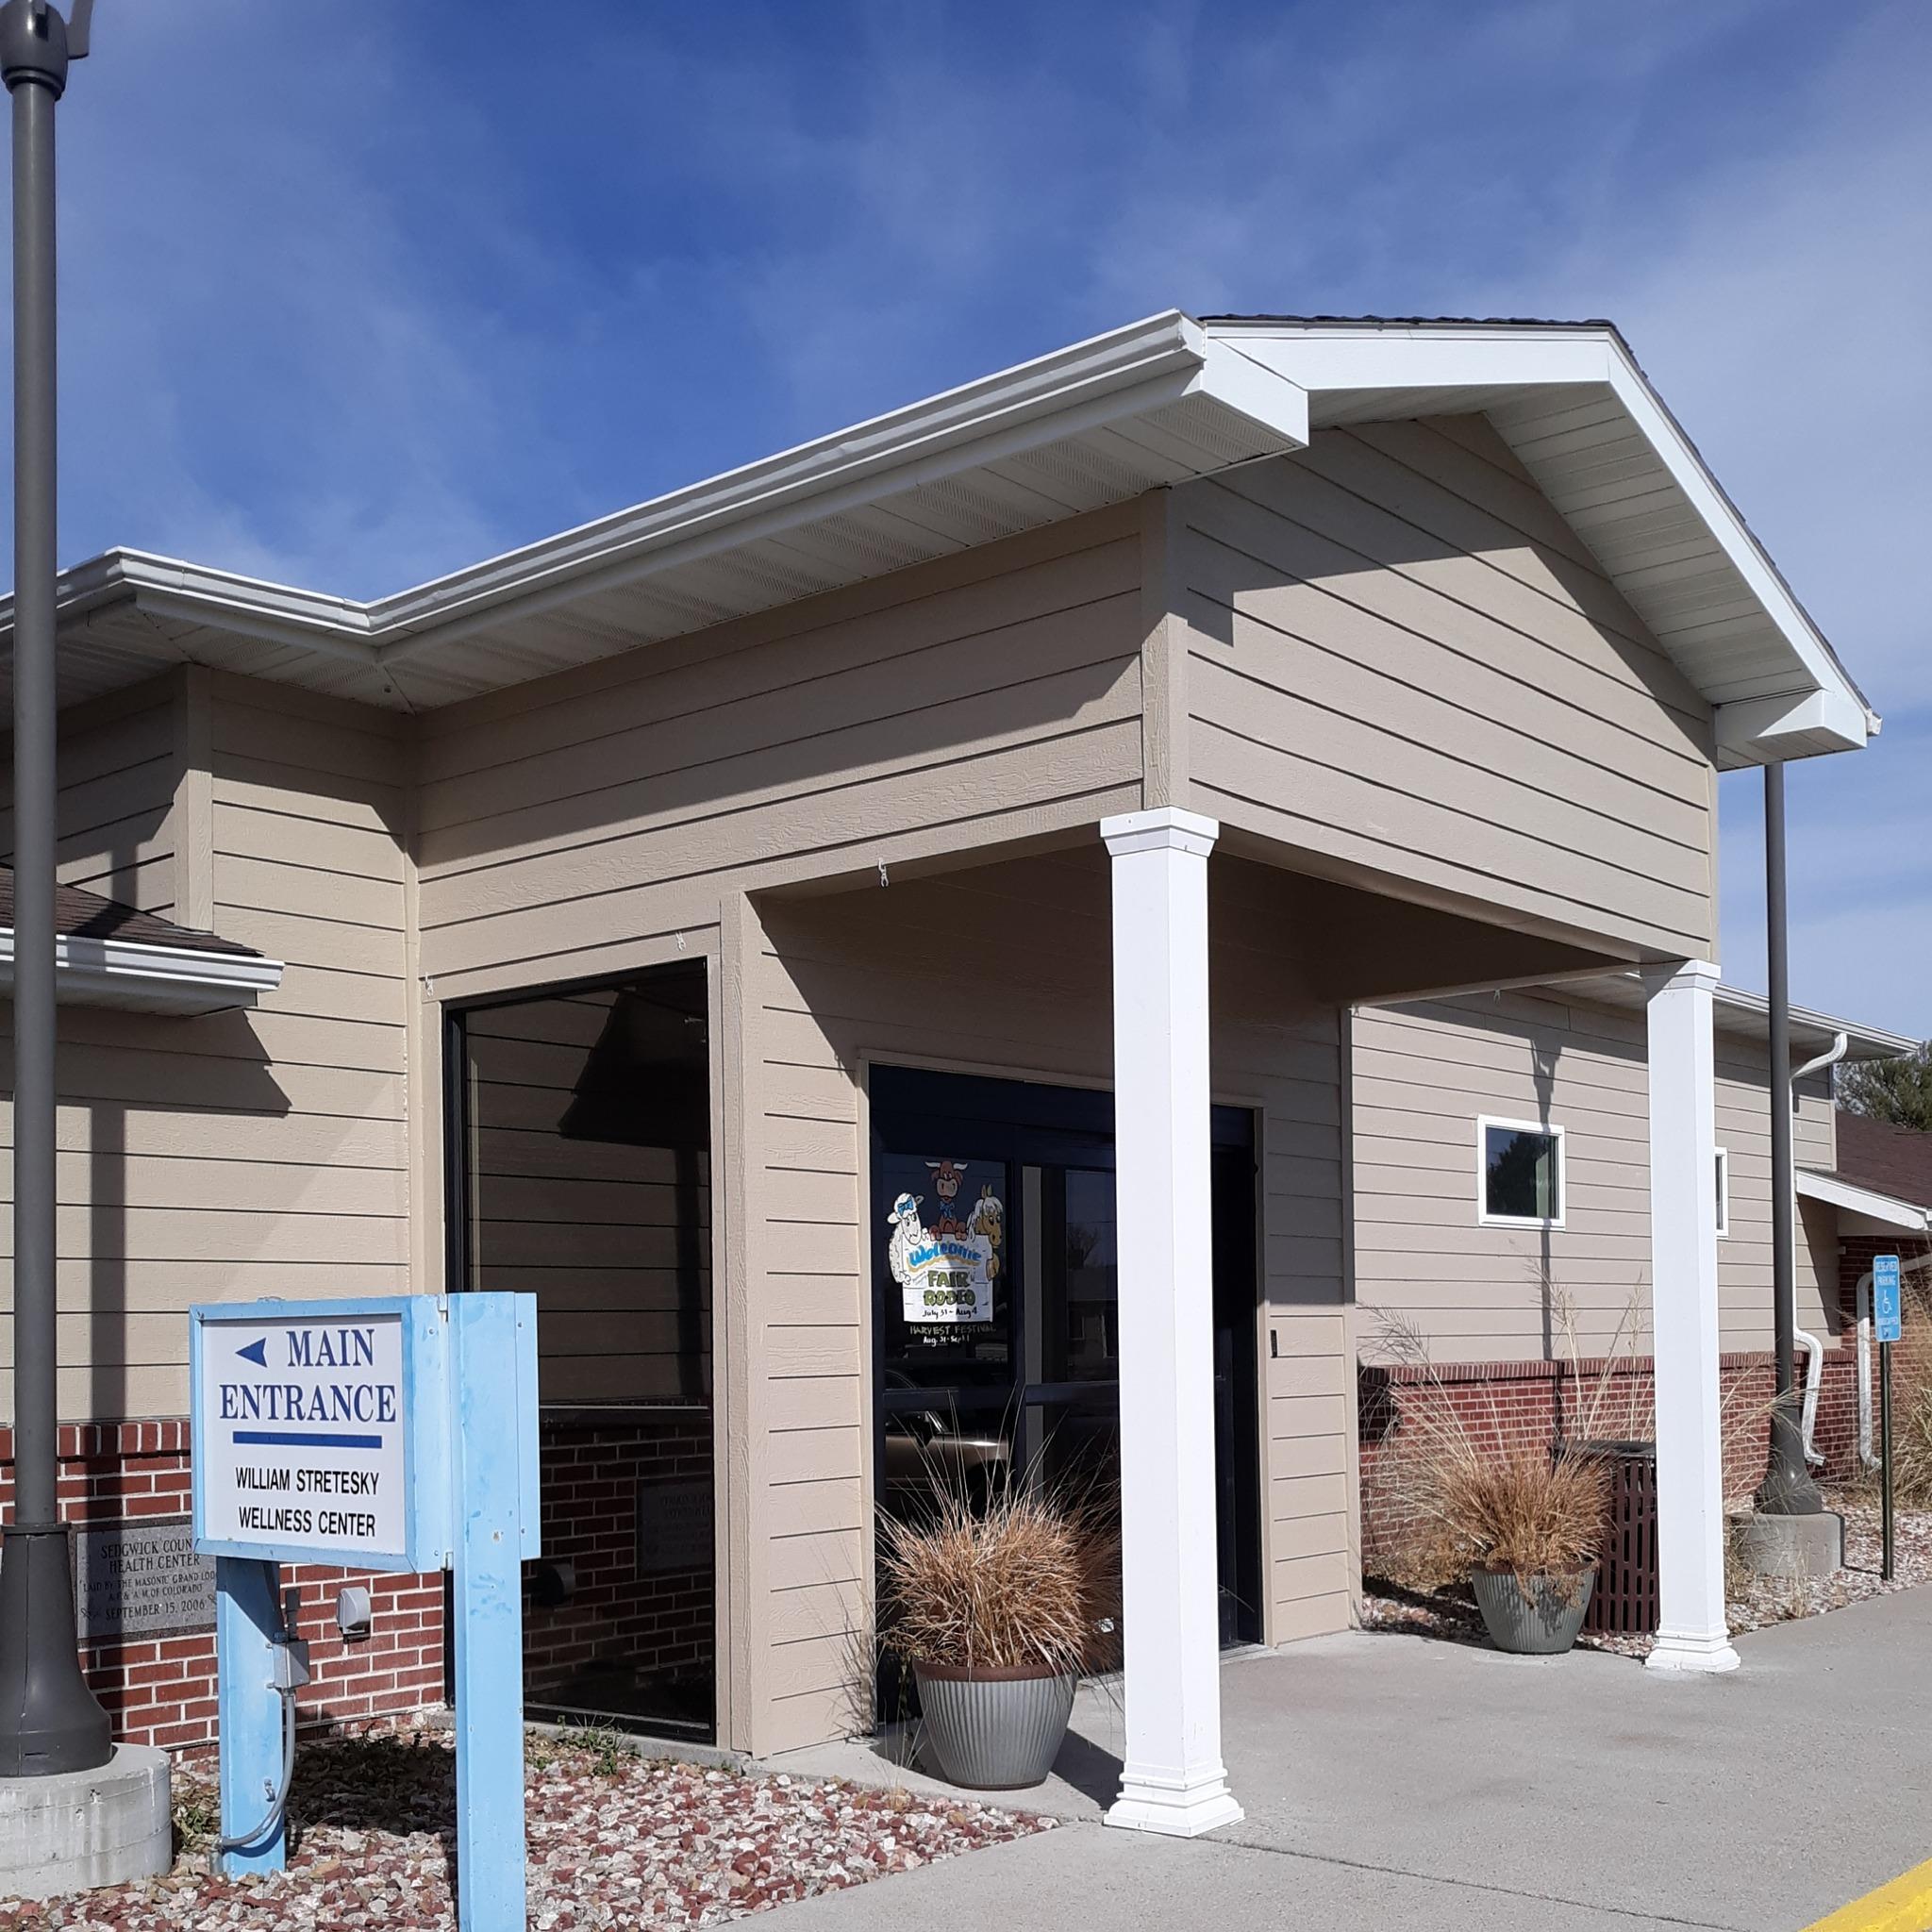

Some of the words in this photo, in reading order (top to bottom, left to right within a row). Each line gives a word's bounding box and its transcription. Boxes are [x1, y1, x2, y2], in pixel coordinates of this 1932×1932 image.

[908, 1242, 982, 1267] Welcome
[927, 1270, 970, 1287] FAIR
[924, 1290, 975, 1306] RODEO
[922, 1309, 938, 1320] July
[909, 1324, 951, 1335] HARVEST
[286, 1328, 375, 1367] MAIN
[219, 1383, 396, 1423] ENTRANCE
[235, 1467, 291, 1491] WILLIAM
[296, 1470, 379, 1496] STRETESKY
[239, 1507, 312, 1533] WELLNESS
[318, 1511, 375, 1538] CENTER
[101, 1541, 158, 1559] SEDGWICK
[163, 1539, 192, 1554] COUN
[109, 1557, 153, 1574] HEALTH
[158, 1554, 200, 1570] CENTER
[118, 1578, 132, 1589] THE
[135, 1575, 168, 1587] MASONIC
[172, 1573, 198, 1584] GRAND
[201, 1571, 215, 1581] LOD
[162, 1584, 202, 1596] COLORADO
[106, 1603, 159, 1621] SEPTEMBER
[181, 1599, 205, 1612] 2006
